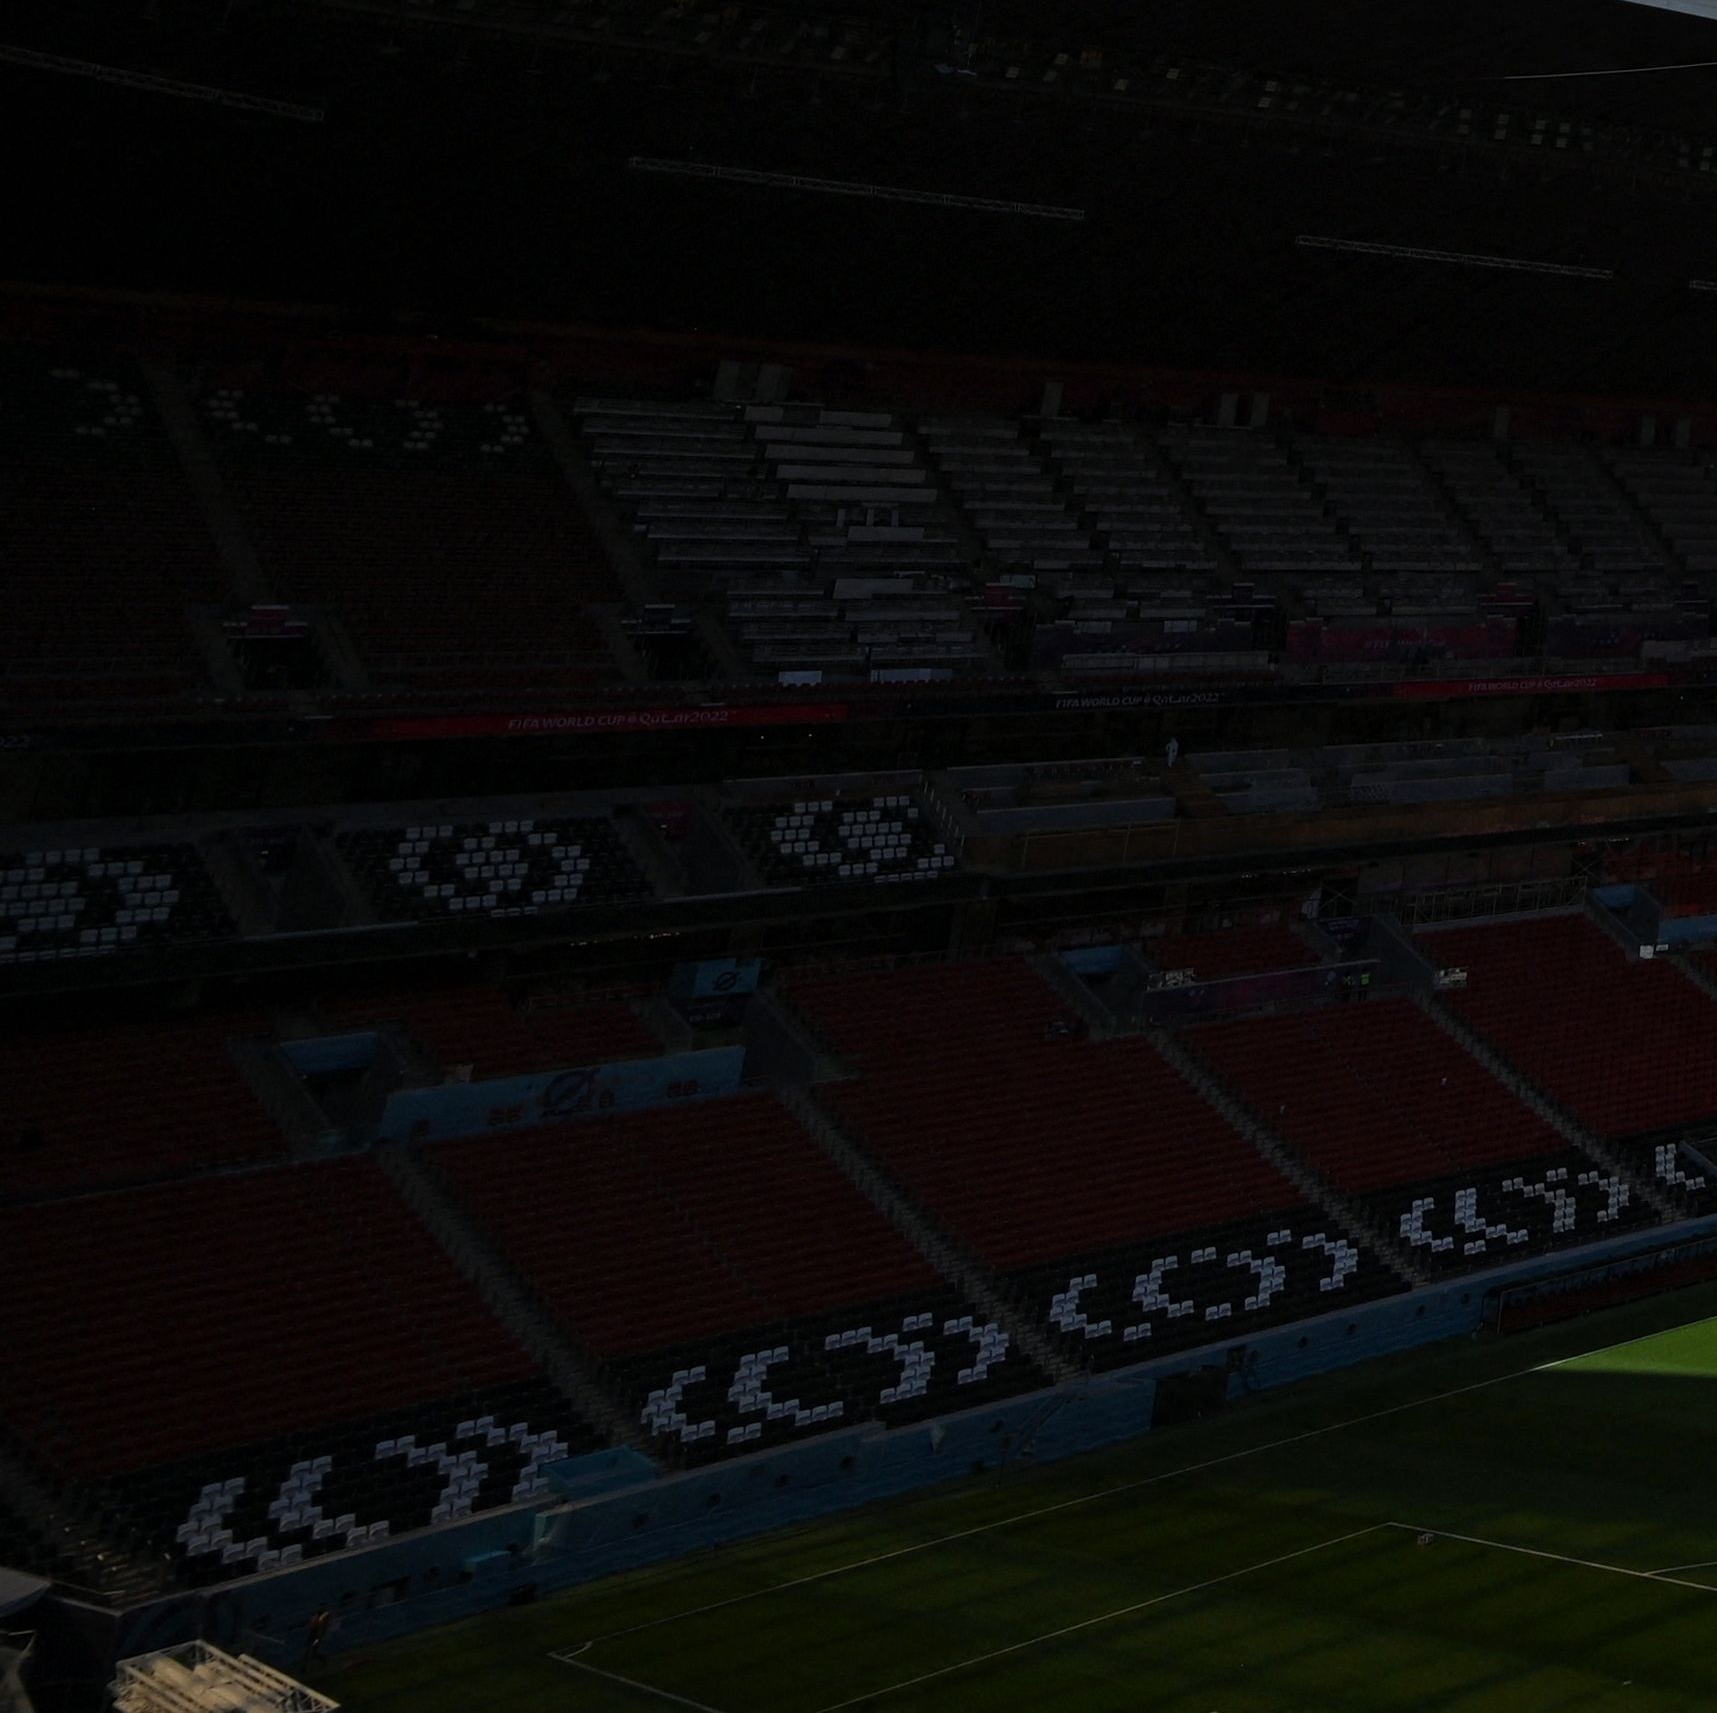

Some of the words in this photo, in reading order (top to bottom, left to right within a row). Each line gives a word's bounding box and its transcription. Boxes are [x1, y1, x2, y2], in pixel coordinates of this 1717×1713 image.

[1055, 698, 1080, 708] FIFA
[1080, 696, 1121, 708] WORLD
[1121, 696, 1143, 706] CUP
[508, 717, 540, 730] FIFA
[542, 715, 596, 729] WORLD
[597, 714, 626, 727] CUP
